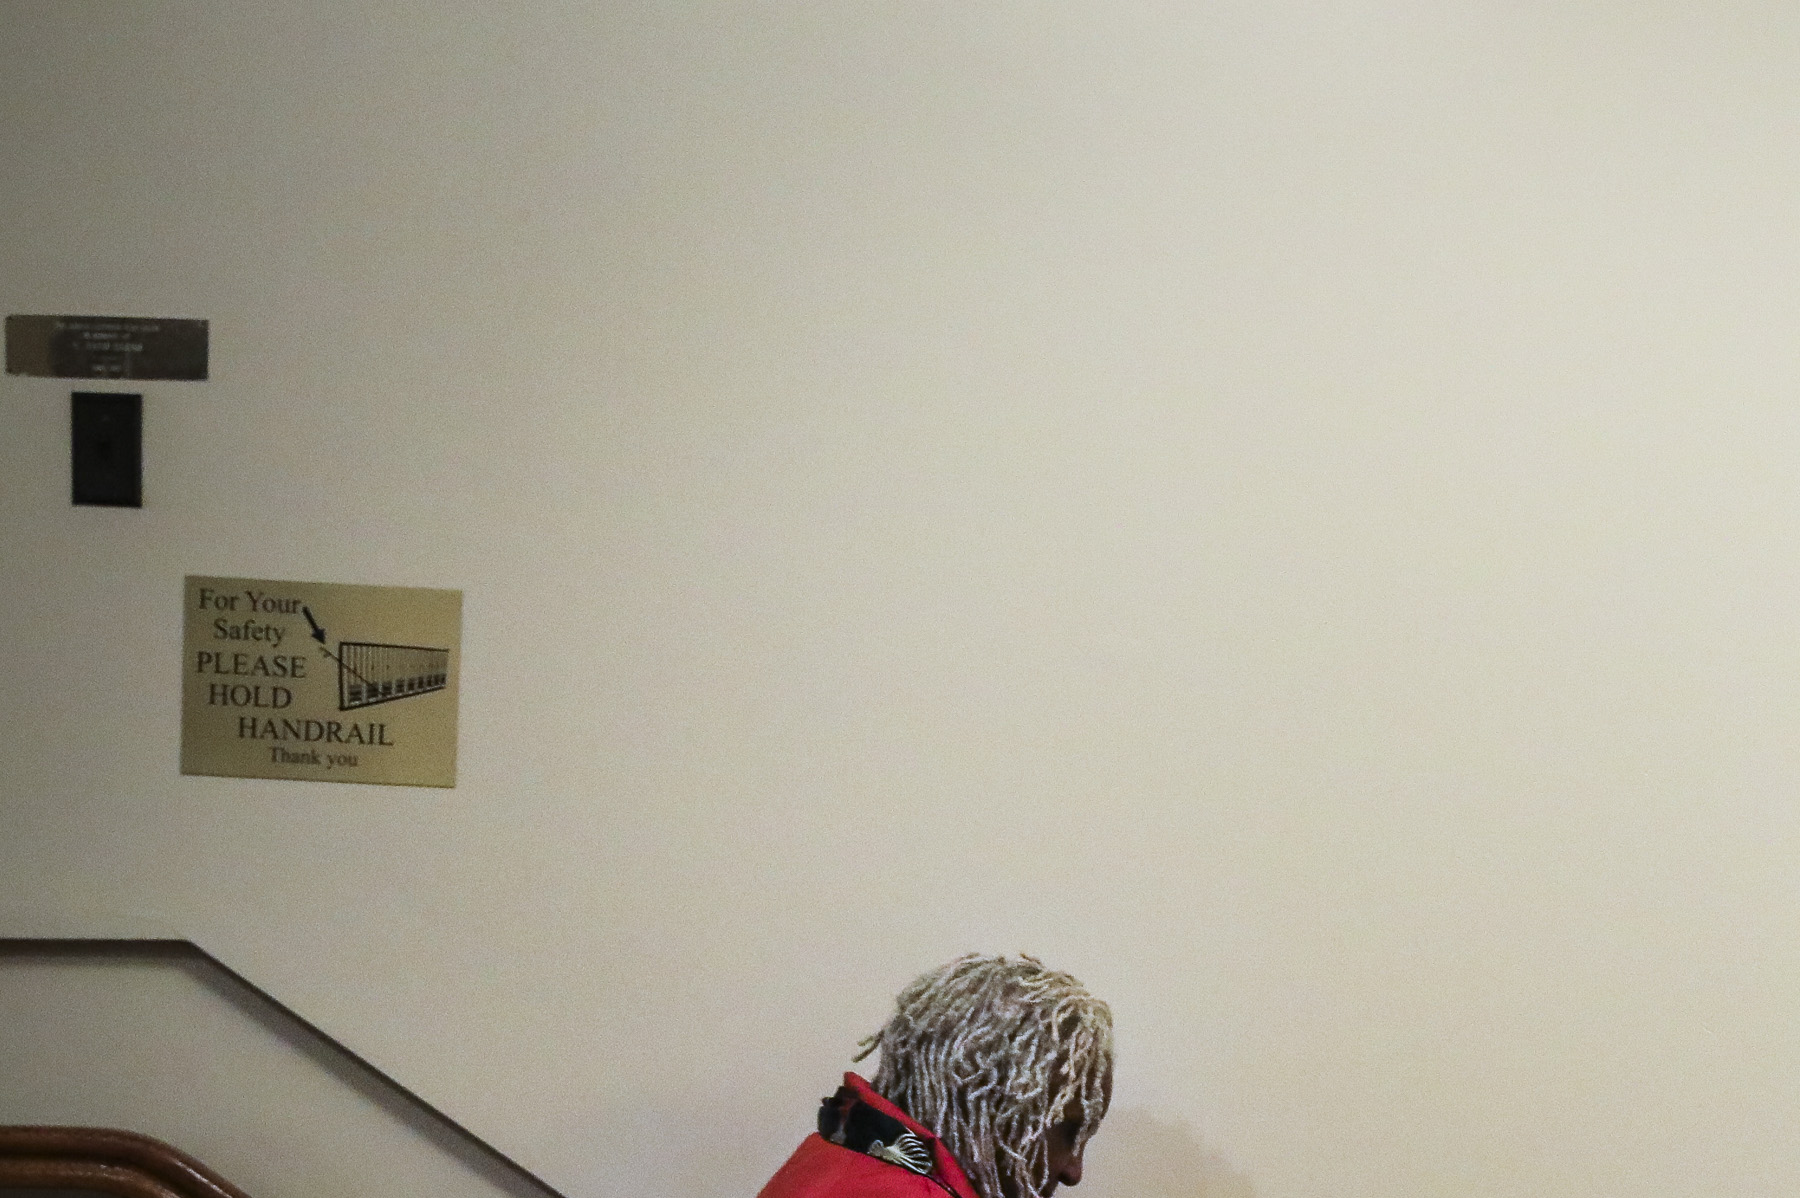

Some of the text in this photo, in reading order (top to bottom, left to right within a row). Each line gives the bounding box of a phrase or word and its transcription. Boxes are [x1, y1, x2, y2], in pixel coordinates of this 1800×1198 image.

[199, 589, 301, 614] For Your
[213, 618, 286, 648] Safety
[197, 651, 307, 679] PLEASE
[209, 683, 293, 709] HOLD
[238, 716, 395, 747] HANDRAIL
[271, 747, 359, 770] Thank you
